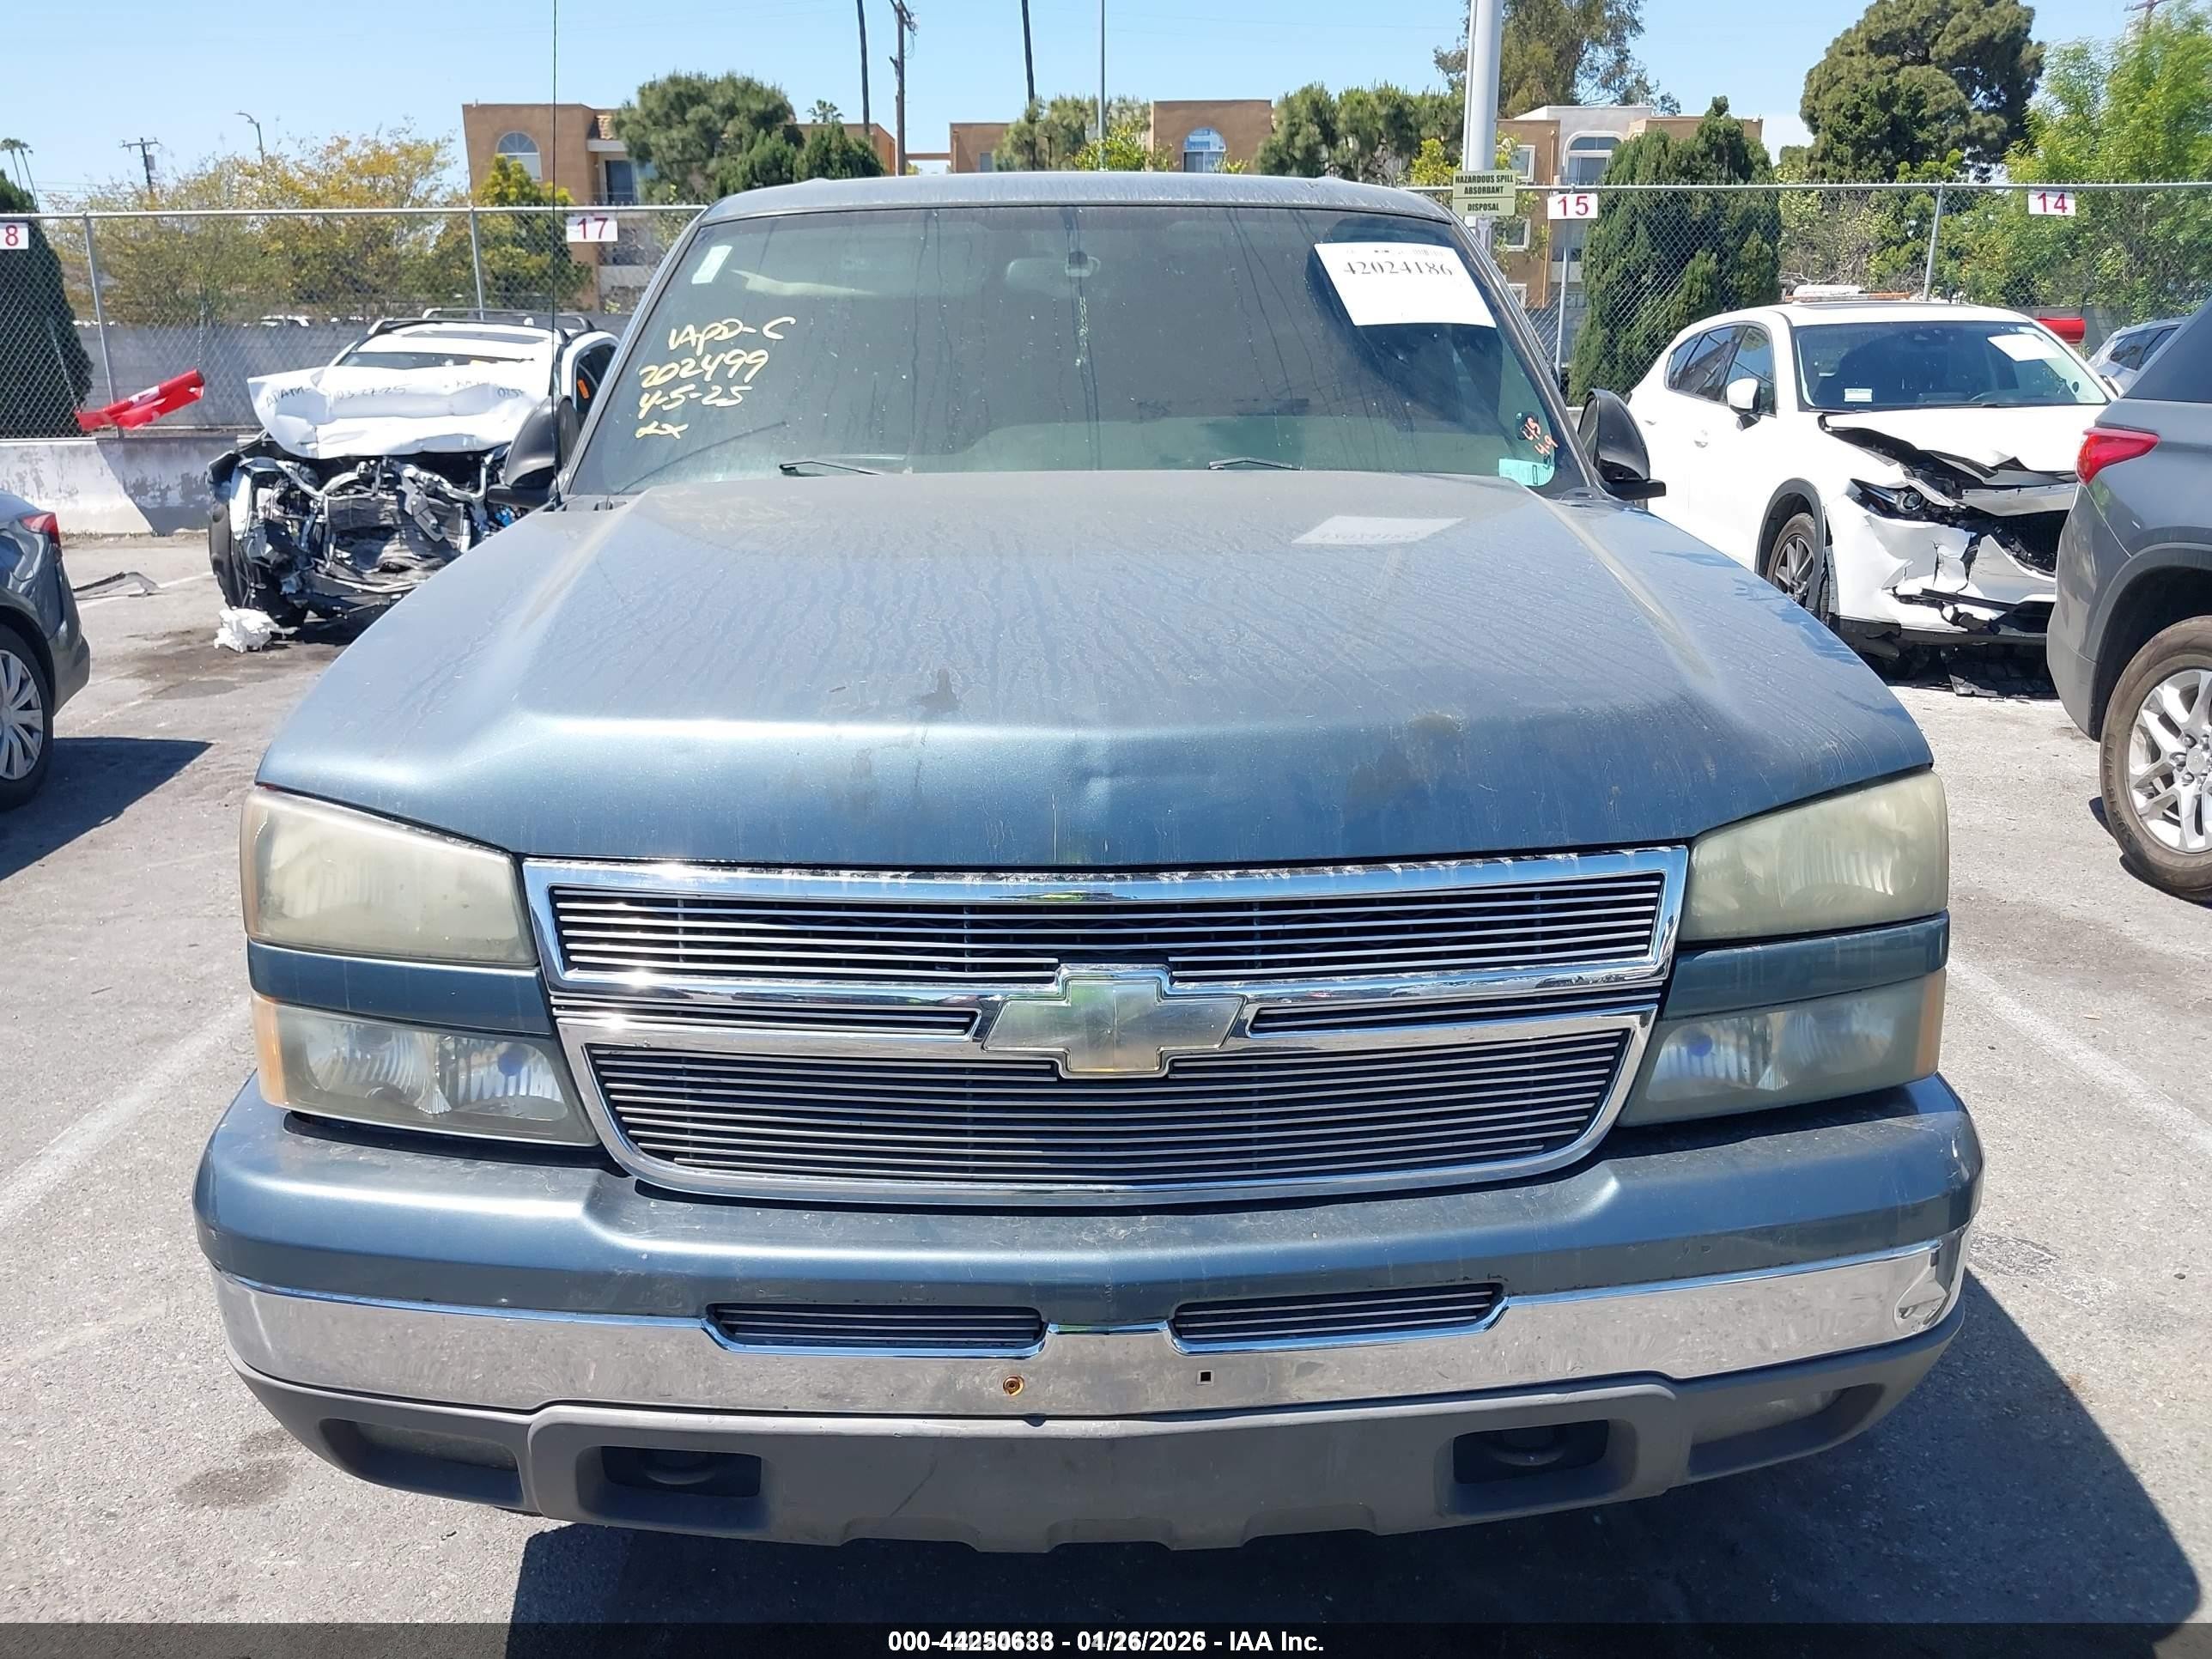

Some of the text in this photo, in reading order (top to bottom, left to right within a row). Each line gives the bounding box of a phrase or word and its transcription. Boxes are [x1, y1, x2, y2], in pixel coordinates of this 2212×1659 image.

[1455, 174, 1513, 184] HAZARDOUS SPILL
[1464, 185, 1504, 194] ABSORBANT
[1468, 203, 1498, 211] DISPOSAL
[1558, 196, 1589, 216] 15
[2038, 192, 2067, 213] 14
[6, 225, 19, 246] 8
[578, 217, 608, 240] 17
[1343, 260, 1453, 276] 42024186
[639, 349, 769, 388] 202499
